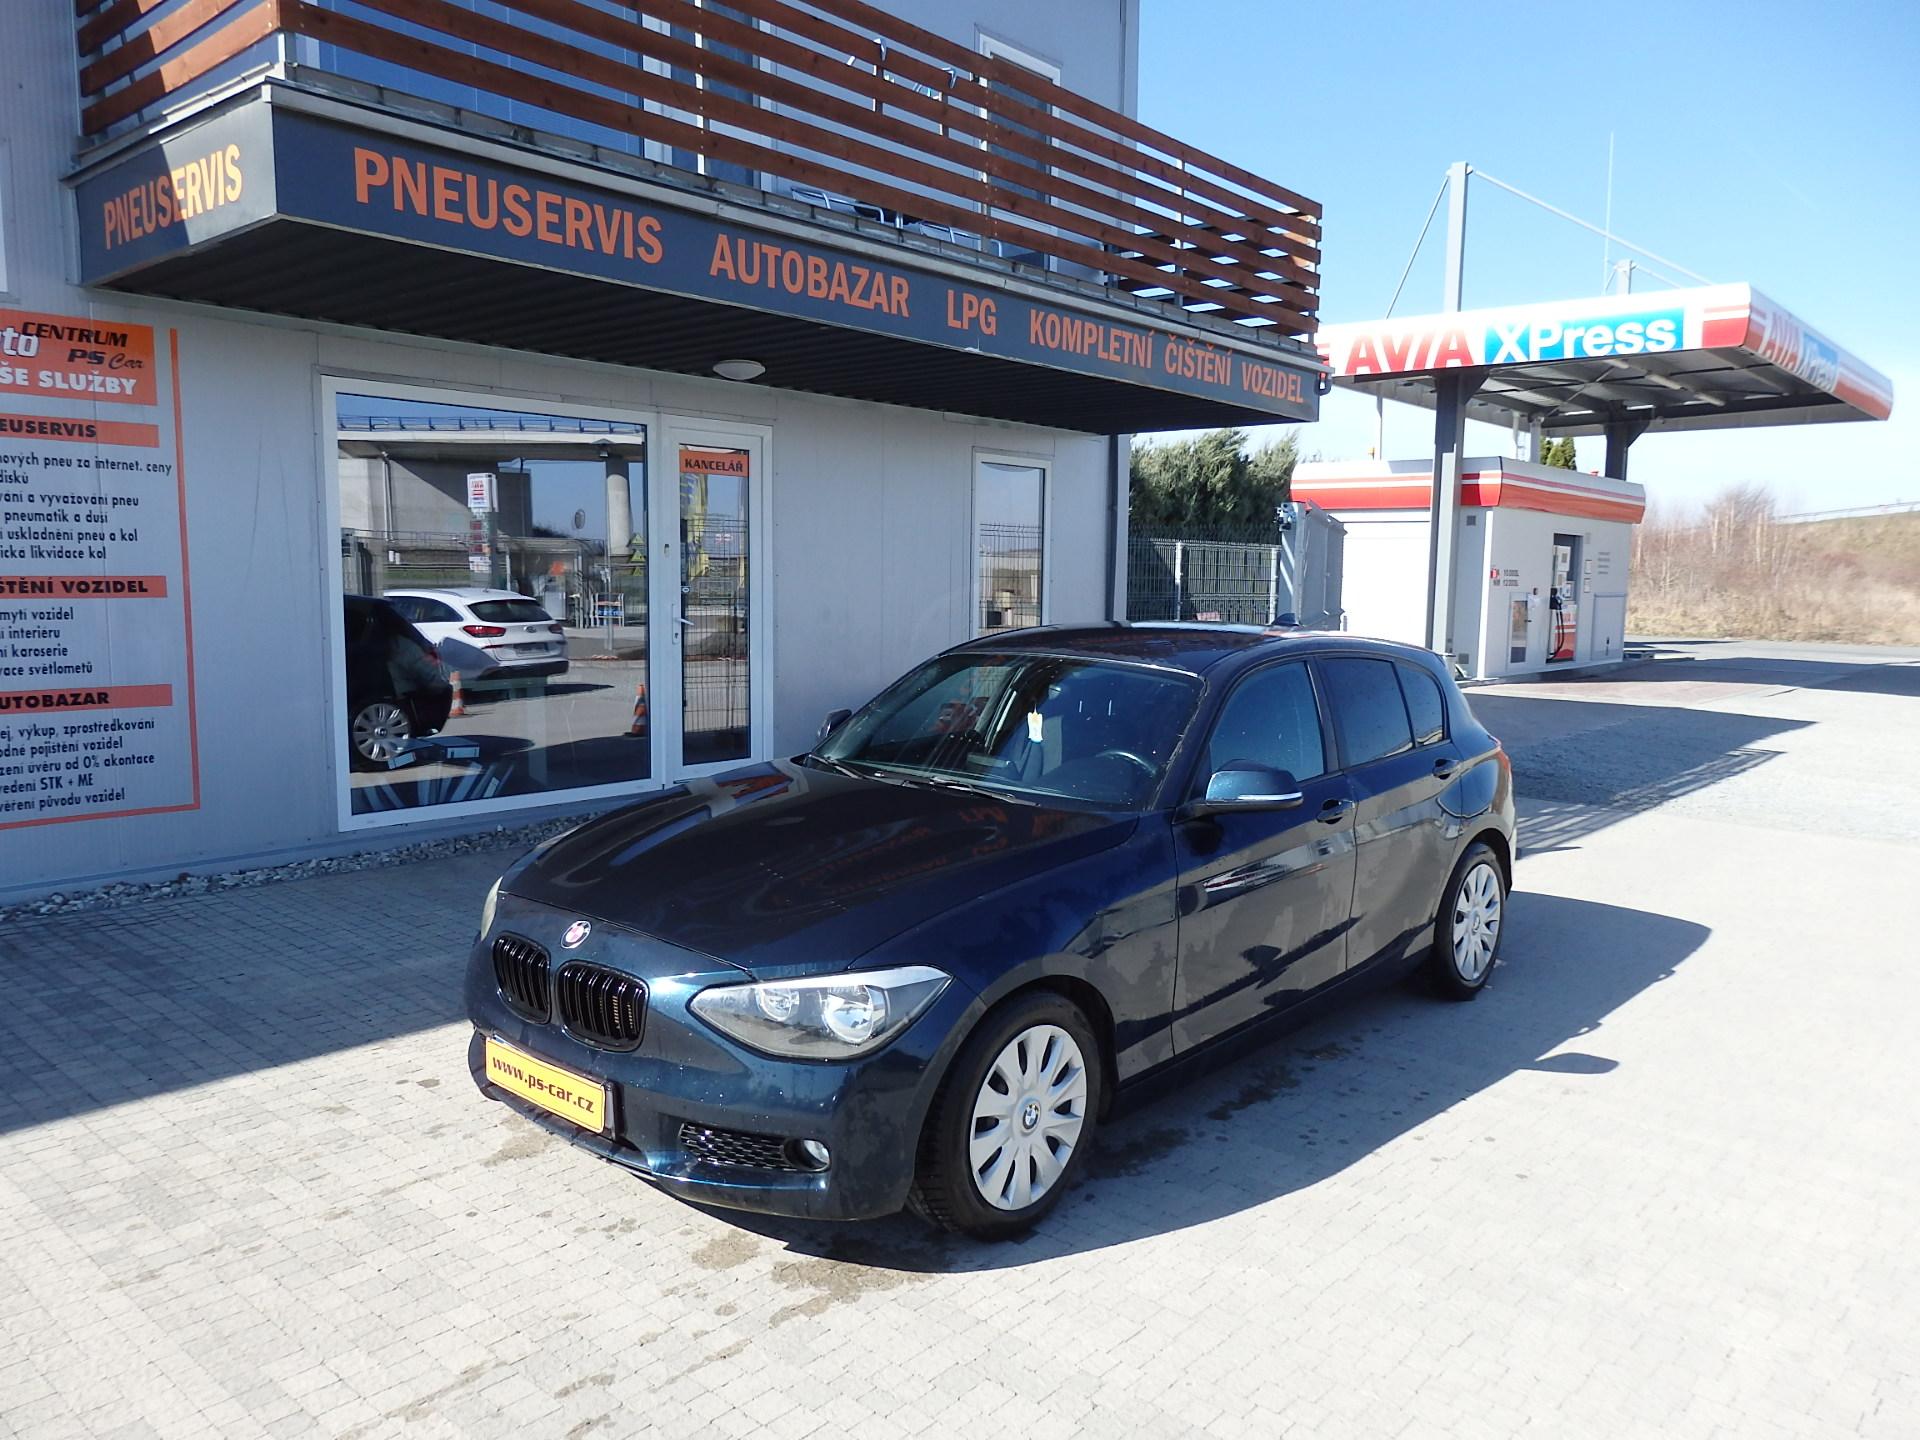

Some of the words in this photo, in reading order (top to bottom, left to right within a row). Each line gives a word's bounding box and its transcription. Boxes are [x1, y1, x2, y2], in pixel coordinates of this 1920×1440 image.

[104, 144, 243, 250] PNEUSERVIS
[354, 147, 664, 264] PNEUSERVIS
[710, 233, 911, 318] AUTOBAZAR
[947, 289, 998, 336] LPG
[1029, 308, 1156, 369] KOMPLETNÍ
[1164, 333, 1233, 386] ČIŠTĚNÍ
[1241, 362, 1304, 404] VOZIDEL
[0, 327, 39, 357] to
[22, 321, 128, 348] CENTRUM
[1344, 327, 1475, 375] AVIA
[1491, 318, 1678, 364] XPress
[67, 348, 106, 365] PS
[108, 353, 145, 371] Car
[39, 369, 137, 395] SLUŽBY
[44, 456, 73, 469] pneu
[77, 458, 91, 468] za
[95, 456, 143, 471] internet.
[146, 463, 172, 476] ceny
[685, 458, 743, 472] KANCELÁŘ
[28, 494, 35, 503] a
[40, 492, 108, 507] vyvažování
[112, 496, 139, 508] pneu
[4, 509, 69, 524] pneumatik
[74, 514, 81, 523] a
[7, 526, 73, 541] uskladnění
[77, 531, 105, 544] pneu
[109, 532, 116, 541] a
[121, 528, 138, 541] kol
[31, 545, 84, 559] likvidace
[89, 546, 106, 559] kol
[61, 580, 148, 593] VOZIDEL
[31, 607, 74, 620] vozidel
[8, 626, 61, 639] interiéru
[12, 643, 68, 657] karoserie
[28, 661, 93, 675] světlometů
[0, 692, 110, 710] UTOBAZAR
[63, 717, 155, 737] zprostředkování
[31, 741, 79, 758] pojištění
[83, 736, 123, 751] vozidel
[28, 762, 61, 774] úvěru
[65, 756, 79, 770] od
[83, 755, 100, 769] 0%
[104, 753, 155, 767] akontace
[40, 775, 63, 790] STK
[40, 792, 81, 811] původu
[85, 787, 125, 803] vozidel
[492, 1056, 595, 1114] www.ps-car.cz
